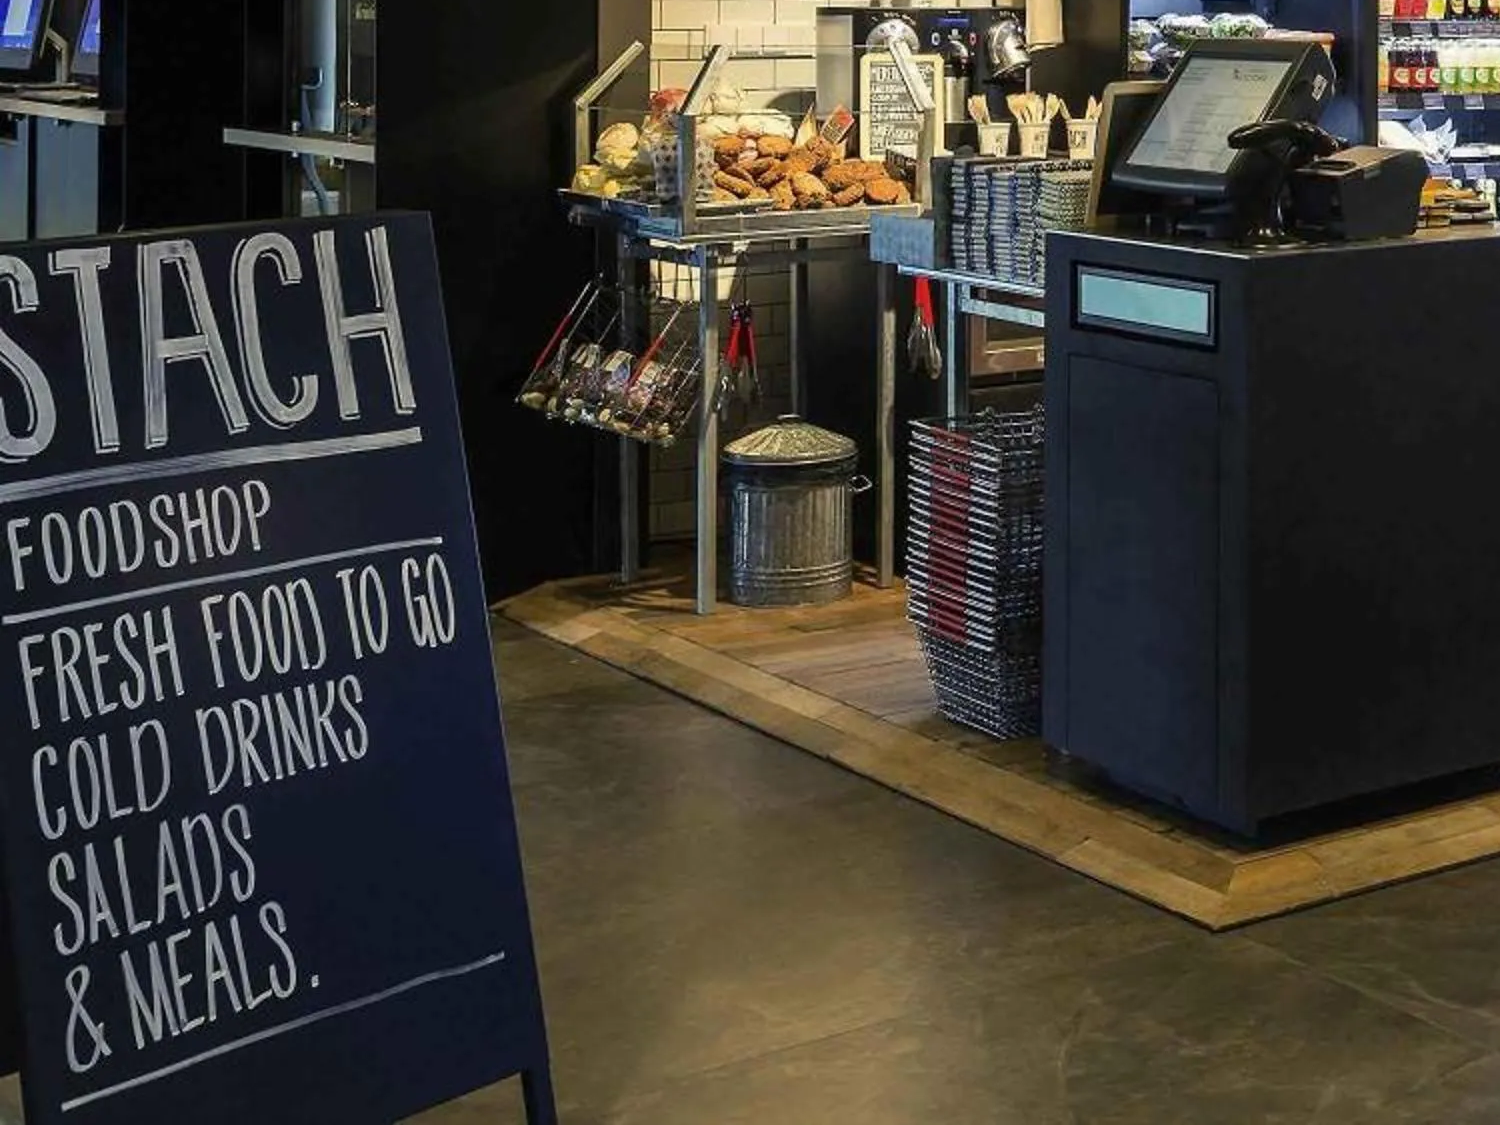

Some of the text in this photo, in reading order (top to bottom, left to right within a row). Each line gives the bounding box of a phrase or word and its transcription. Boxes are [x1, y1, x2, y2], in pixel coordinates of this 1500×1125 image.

[0, 225, 418, 464] STACH
[7, 479, 272, 591] FOODSHOP
[18, 551, 455, 730] FRESH FOOD TO GO
[32, 673, 370, 841] COLD DRINKS
[48, 803, 257, 957] SALADS
[64, 964, 112, 1074] &
